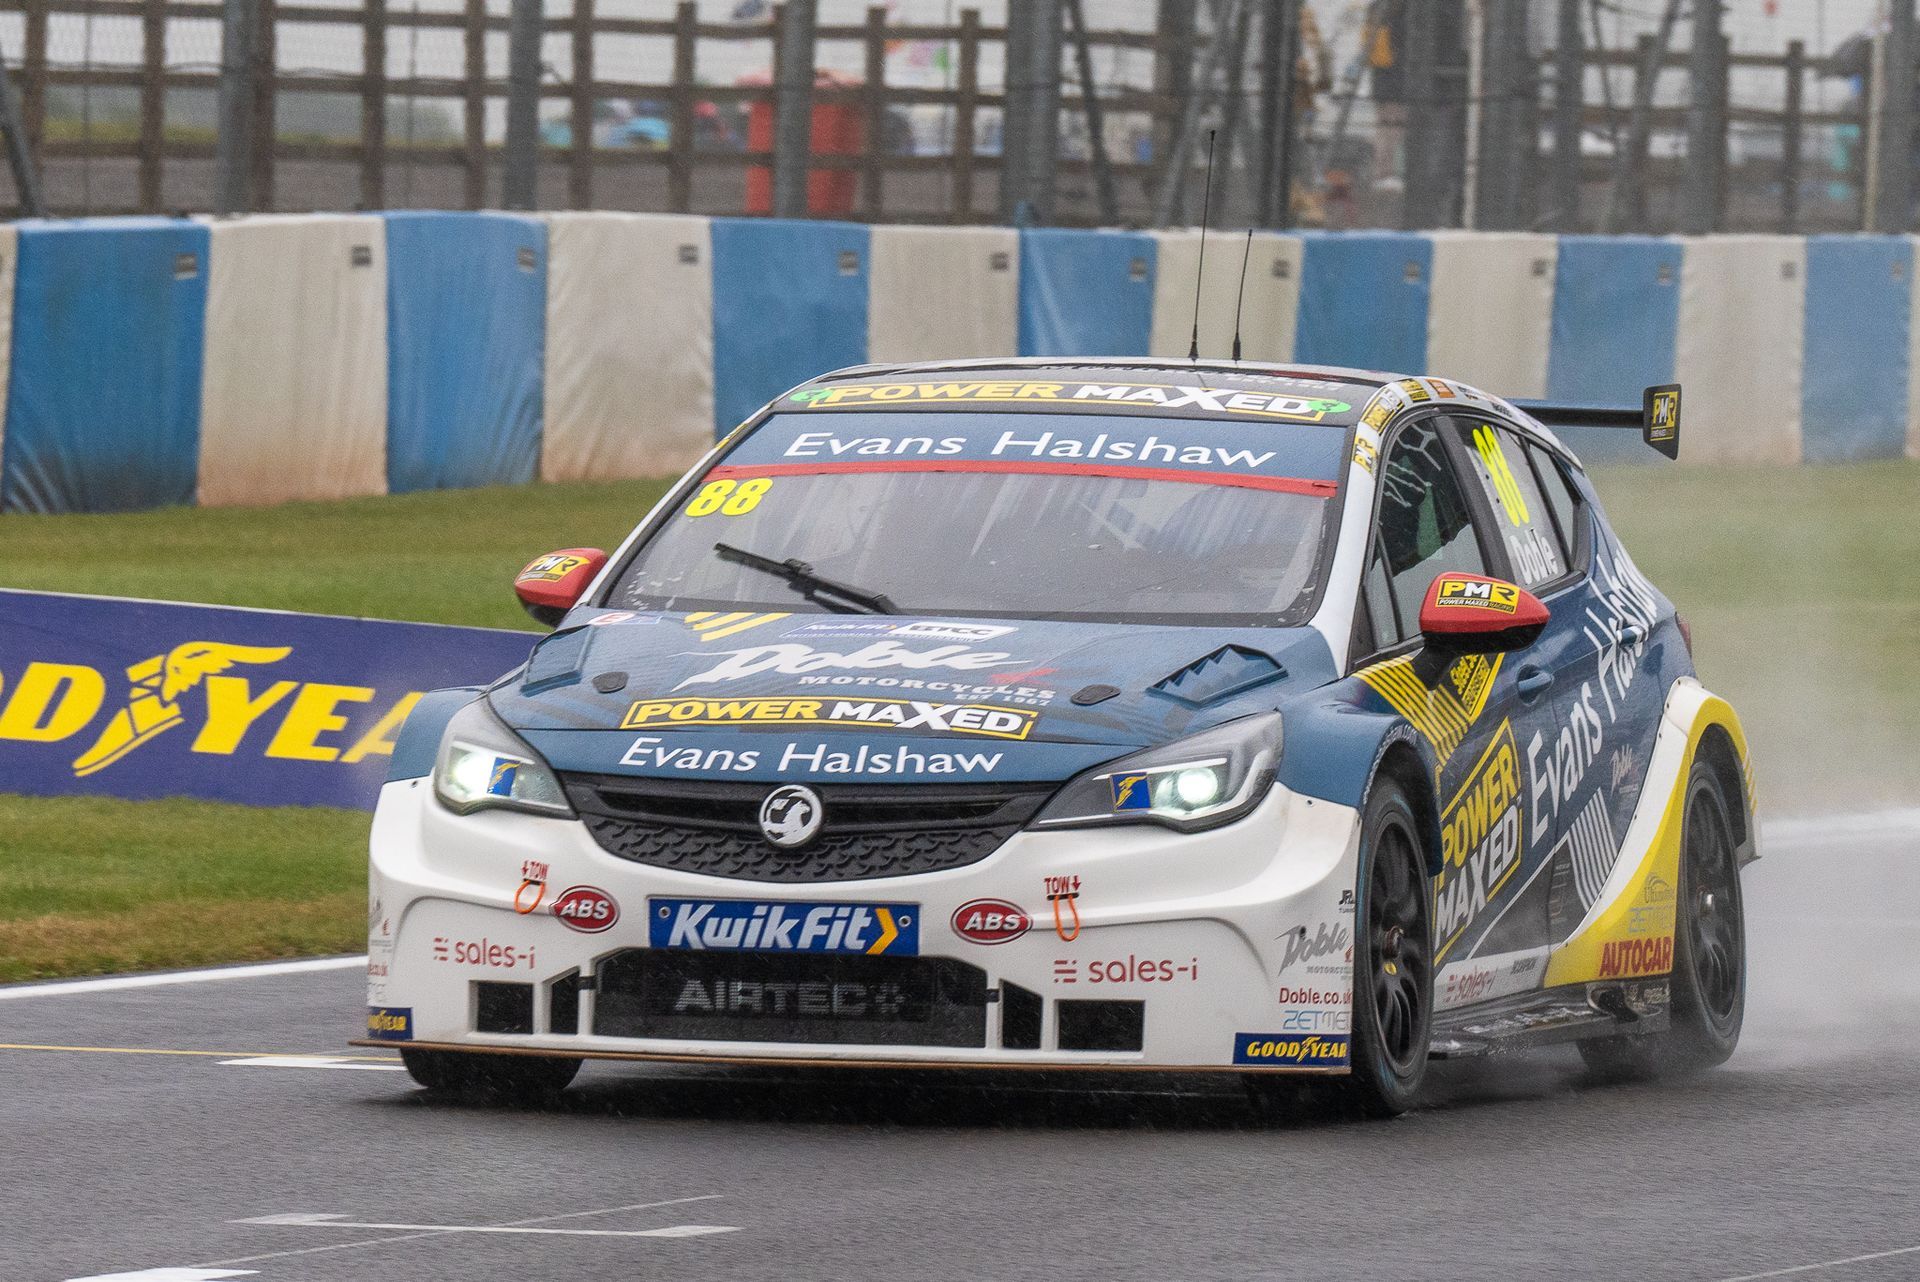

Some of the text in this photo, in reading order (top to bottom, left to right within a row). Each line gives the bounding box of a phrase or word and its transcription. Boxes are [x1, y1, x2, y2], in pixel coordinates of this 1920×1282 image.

[823, 384, 1314, 413] POWER MAXED
[783, 430, 1277, 468] Evans Halshaw
[684, 477, 773, 517] 88
[1439, 598, 1464, 606] POWER
[1442, 581, 1516, 602] PMR
[666, 641, 1034, 692] Doble
[798, 676, 1057, 699] MOTORCYCLES
[0, 660, 426, 764] D YEA
[634, 700, 1024, 732] POWER MAXED
[618, 736, 1004, 775] Evans Halshaw
[1527, 680, 1603, 848] Evans
[1440, 743, 1518, 868] POWER
[1045, 876, 1070, 894] TOW
[1434, 804, 1519, 952] MAXED
[560, 898, 611, 920] ABS
[964, 911, 1023, 932] ABS
[453, 937, 536, 969] sales-i
[1274, 921, 1349, 977] Doble
[1599, 935, 1672, 977] AUTOCAR
[1089, 954, 1198, 983] sales-i
[674, 980, 867, 1015] AIRTEC
[1247, 1039, 1348, 1061] GOODYEAR
